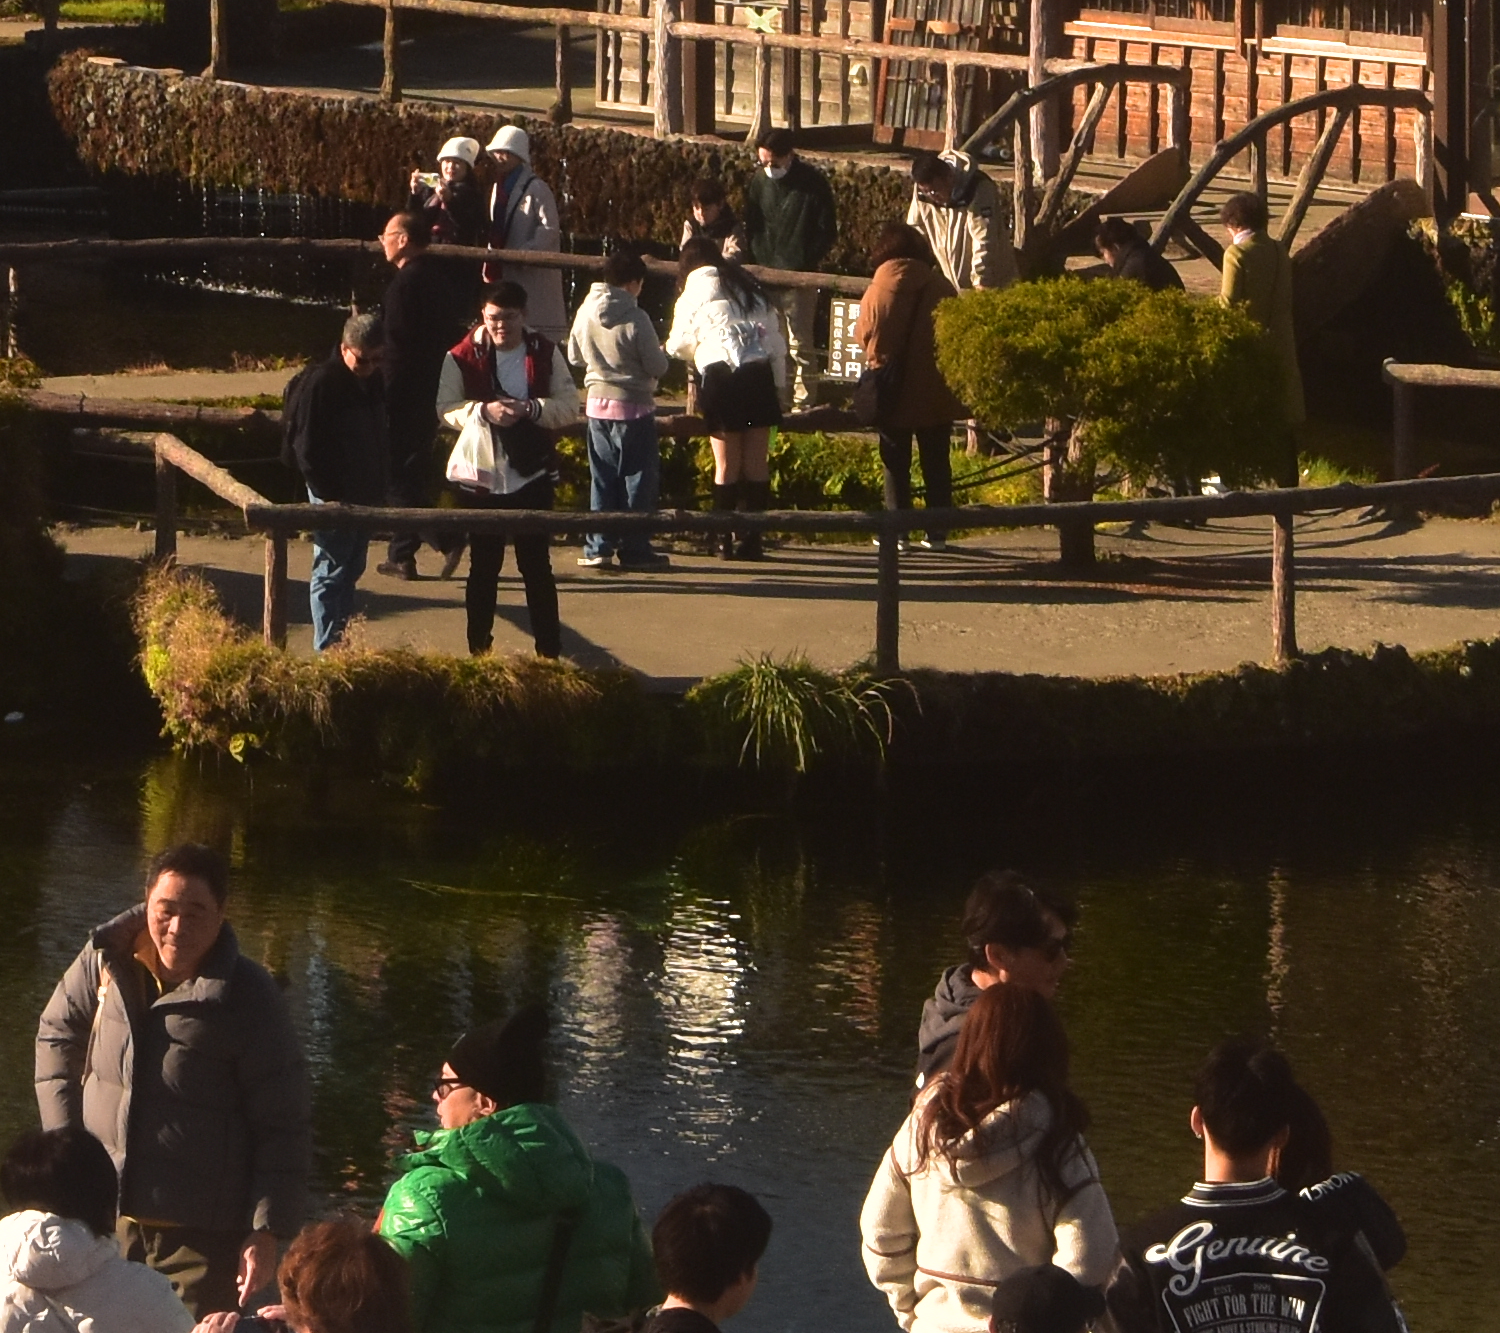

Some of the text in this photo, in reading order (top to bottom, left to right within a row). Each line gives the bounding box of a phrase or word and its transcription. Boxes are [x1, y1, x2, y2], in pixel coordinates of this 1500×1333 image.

[1144, 1220, 1330, 1296] Genuine
[1183, 1293, 1306, 1328] FIGHT FOR THE WIN
